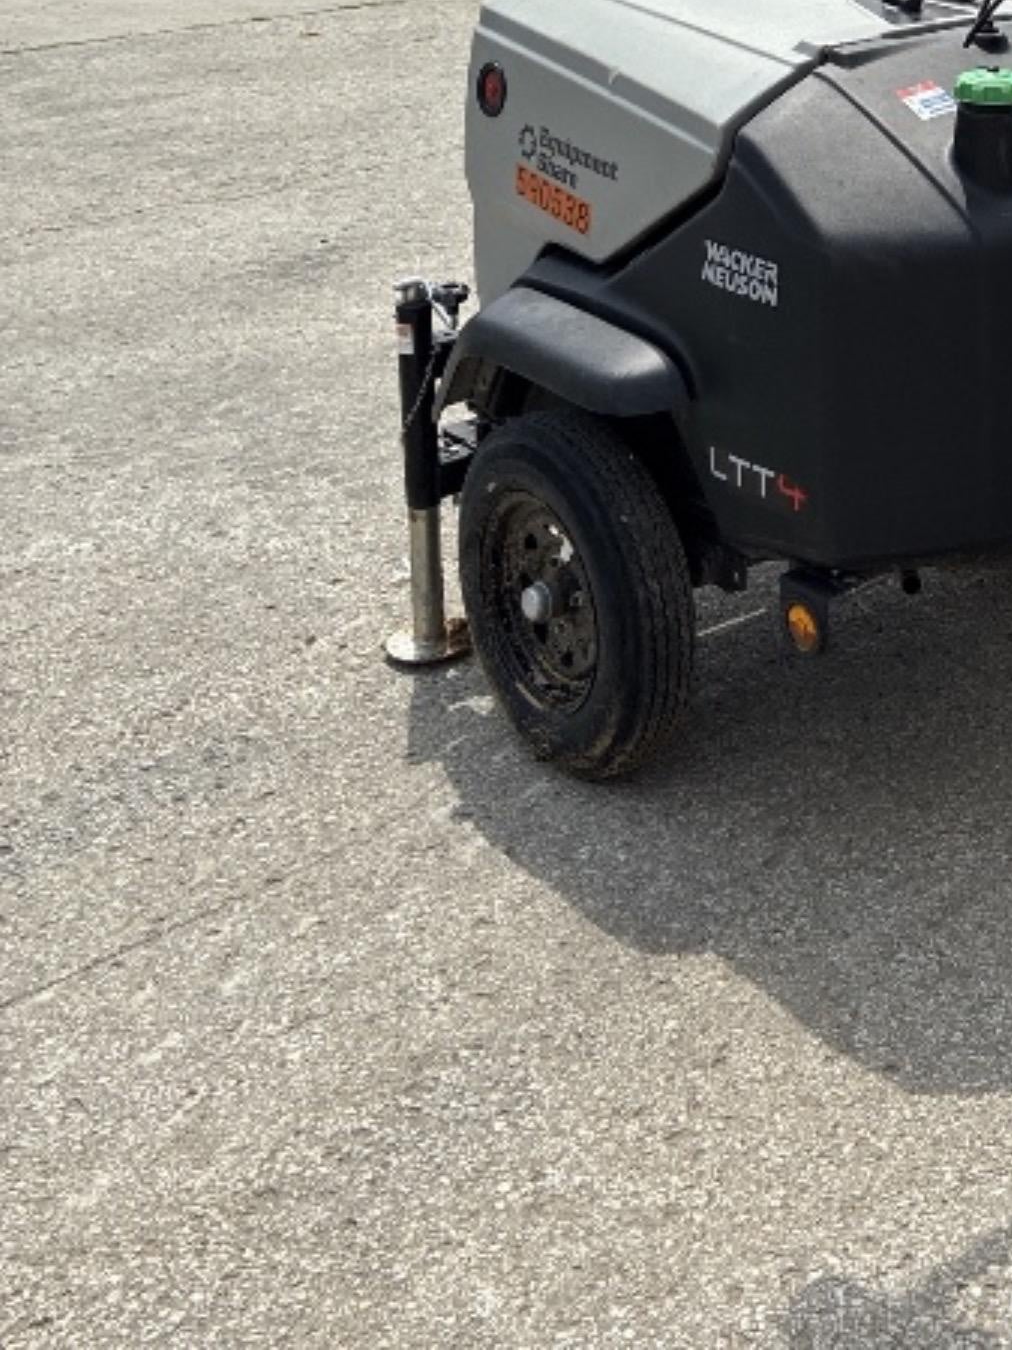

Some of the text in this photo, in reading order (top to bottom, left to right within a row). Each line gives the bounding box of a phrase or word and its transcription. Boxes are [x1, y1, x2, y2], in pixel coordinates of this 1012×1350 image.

[701, 262, 778, 308] NEUSON
[703, 240, 778, 286] WACKER
[709, 446, 808, 511] LTT4
